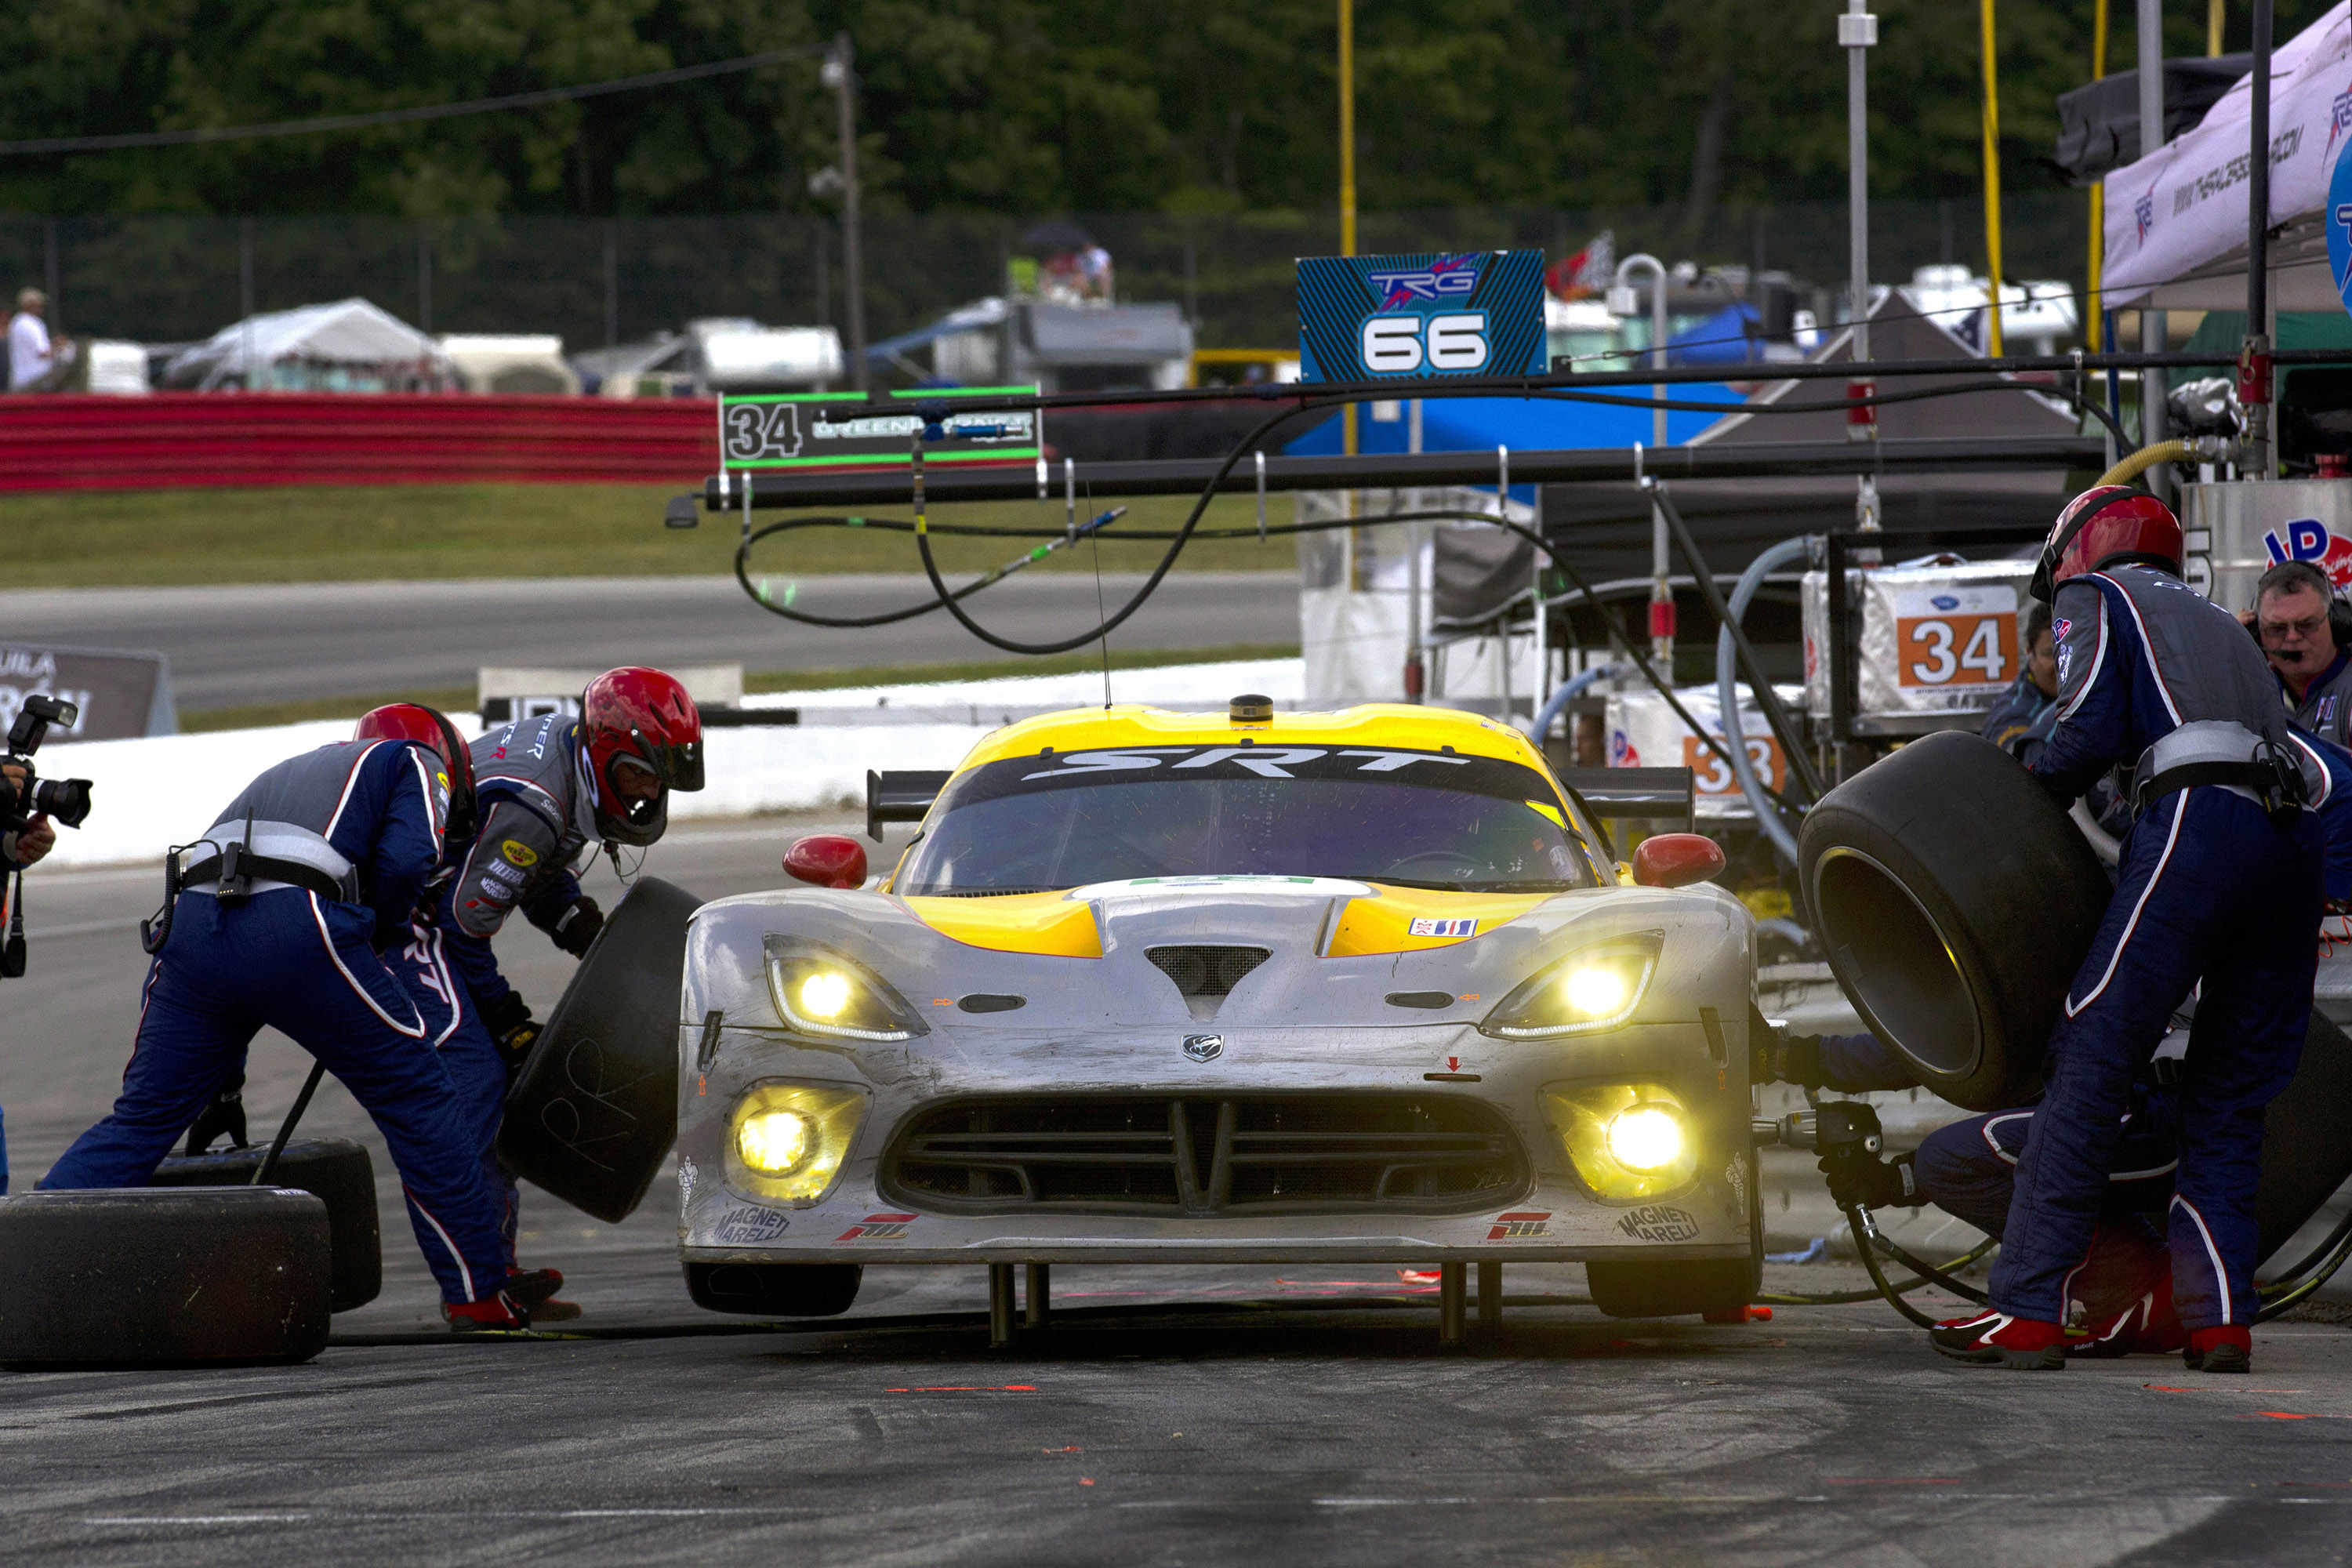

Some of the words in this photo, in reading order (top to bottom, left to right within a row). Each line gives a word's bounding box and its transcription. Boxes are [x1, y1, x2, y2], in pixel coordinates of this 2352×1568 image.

[1370, 271, 1476, 298] TRG
[1363, 314, 1488, 372] 66
[728, 404, 803, 459] 34
[1911, 619, 2005, 684] 34
[1022, 748, 1472, 780] SRT
